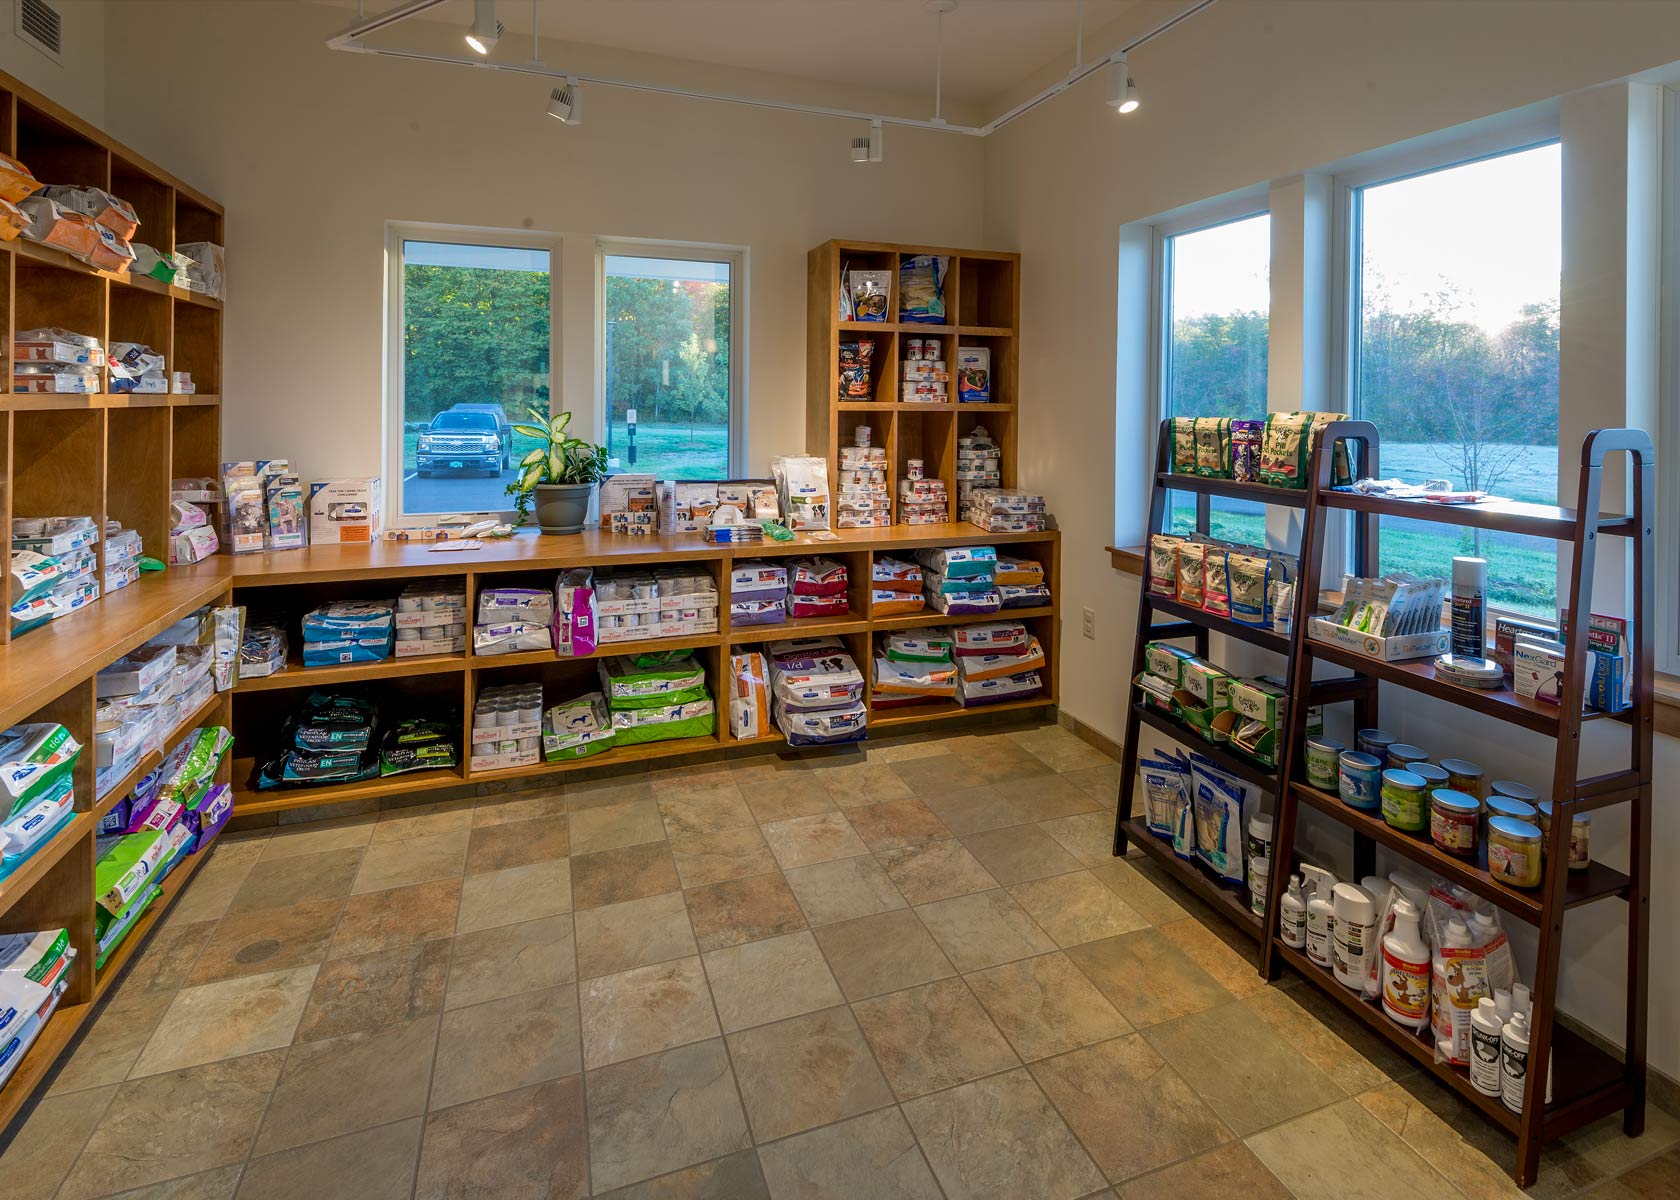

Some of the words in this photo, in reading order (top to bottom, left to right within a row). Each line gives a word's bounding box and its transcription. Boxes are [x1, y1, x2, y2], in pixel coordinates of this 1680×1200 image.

[1276, 441, 1286, 449] Pill
[1515, 650, 1557, 667] NexGard
[331, 732, 342, 740] EN
[321, 759, 332, 767] EN
